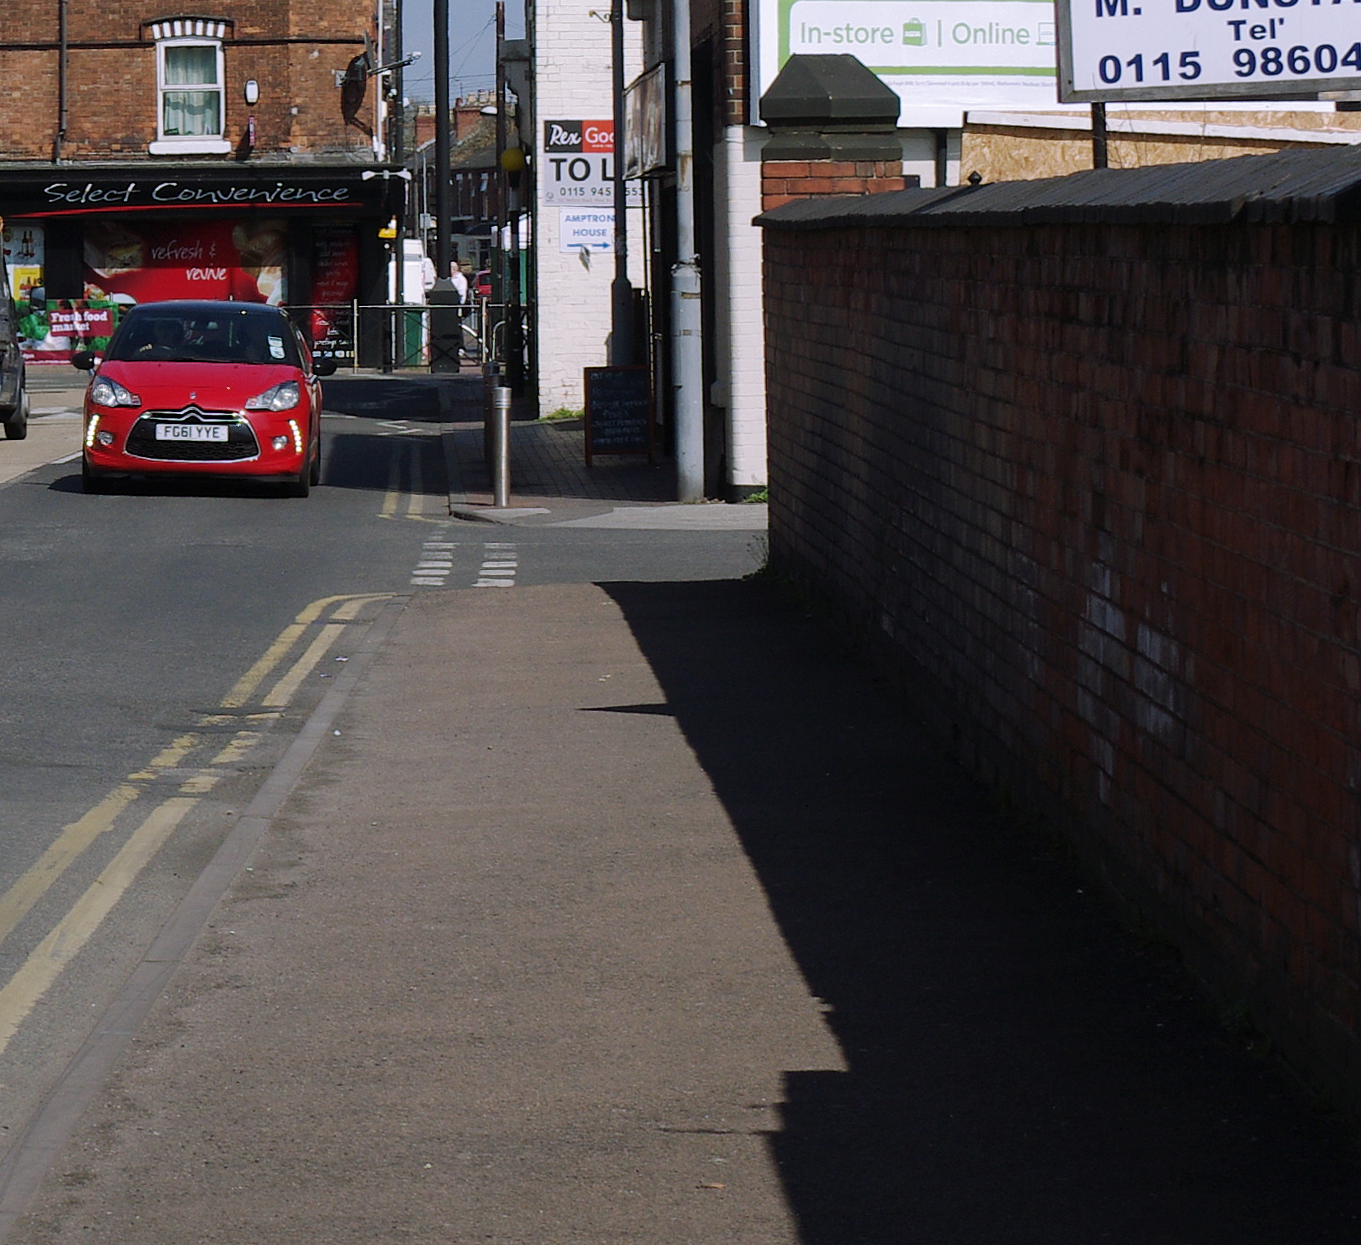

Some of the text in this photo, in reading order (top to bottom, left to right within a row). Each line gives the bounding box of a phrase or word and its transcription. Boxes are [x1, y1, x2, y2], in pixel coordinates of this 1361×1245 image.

[800, 22, 1030, 44] In-store Online
[1098, 42, 1361, 85] 0115 98604
[549, 124, 582, 146] Rex
[549, 157, 591, 182] TO
[43, 182, 350, 203] Select Convenience
[560, 187, 585, 196] 0115
[590, 187, 612, 196] 945
[564, 214, 615, 223] AMPTRON
[573, 229, 607, 237] HOUSE
[150, 239, 203, 261] refresh
[185, 263, 227, 281] revive
[50, 311, 108, 323] Fresh food
[164, 426, 221, 439] FG61 YYE
